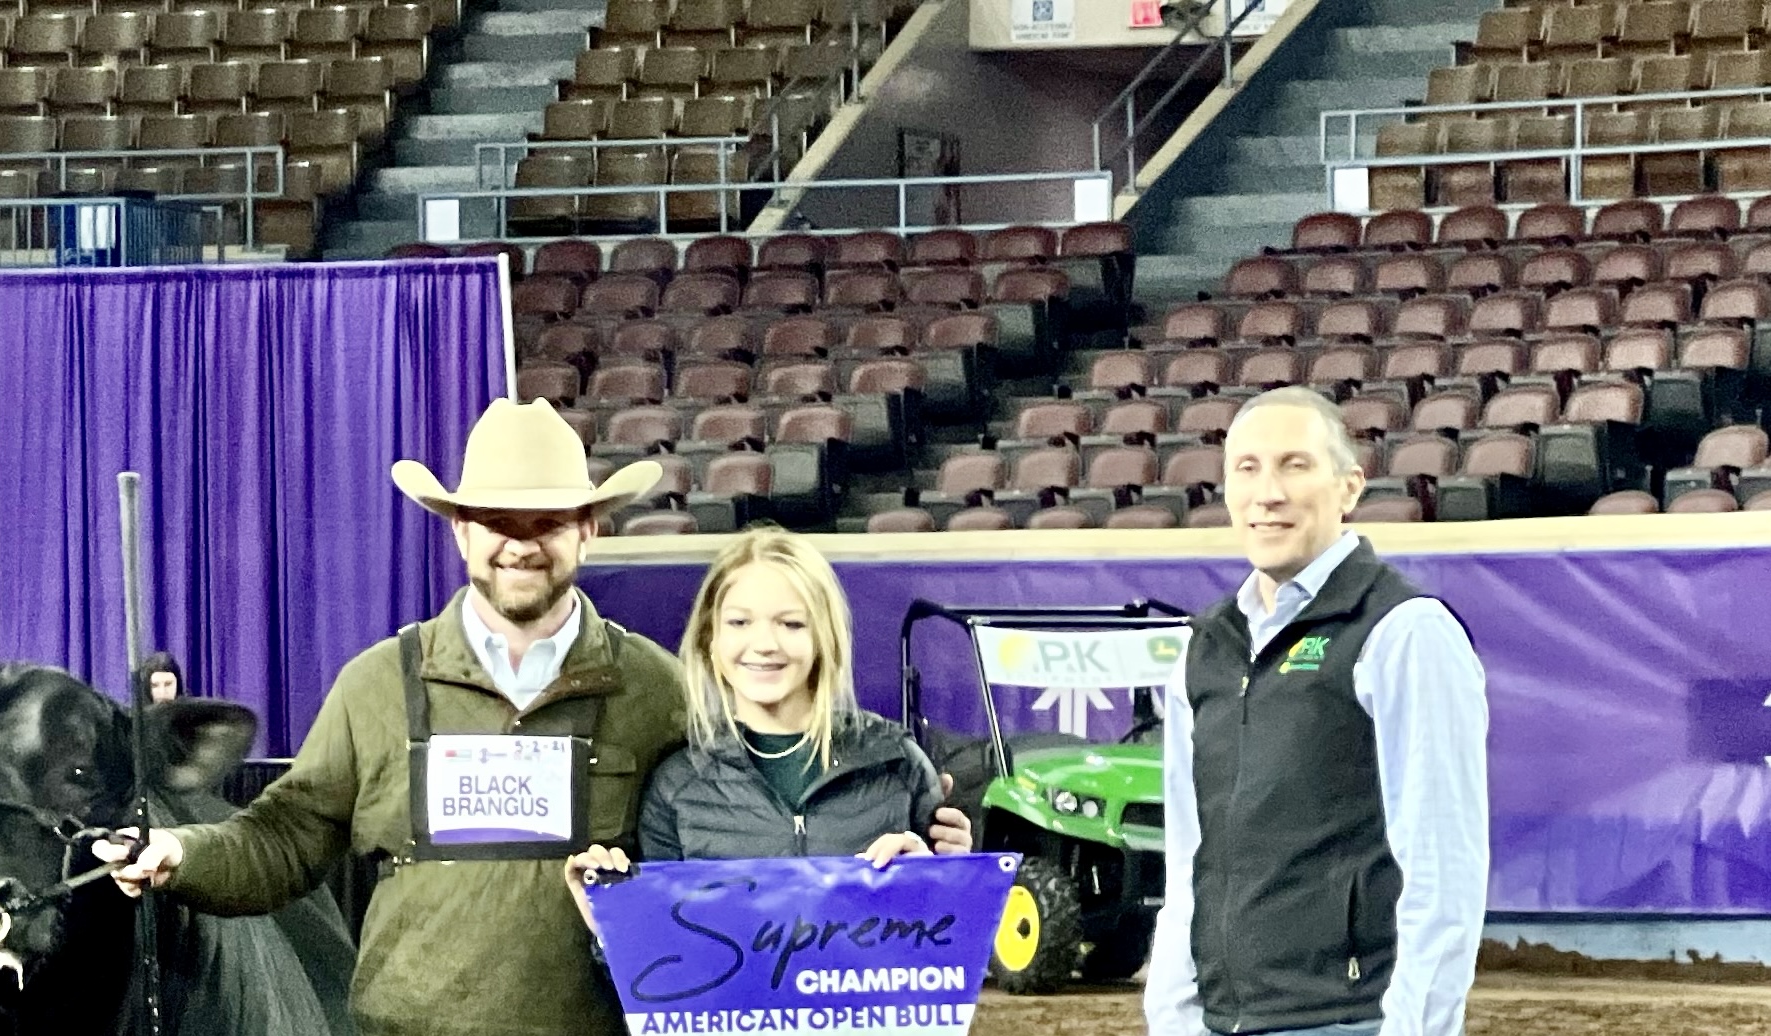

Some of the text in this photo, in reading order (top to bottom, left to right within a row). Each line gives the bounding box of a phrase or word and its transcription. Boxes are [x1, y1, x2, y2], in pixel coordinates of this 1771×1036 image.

[459, 775, 532, 795] BLACK
[442, 796, 549, 817] BRANGUS
[630, 876, 957, 1001] Supreme
[795, 966, 966, 995] CHAMPION
[641, 1003, 965, 1035] AMERICAN OPEN BULL
